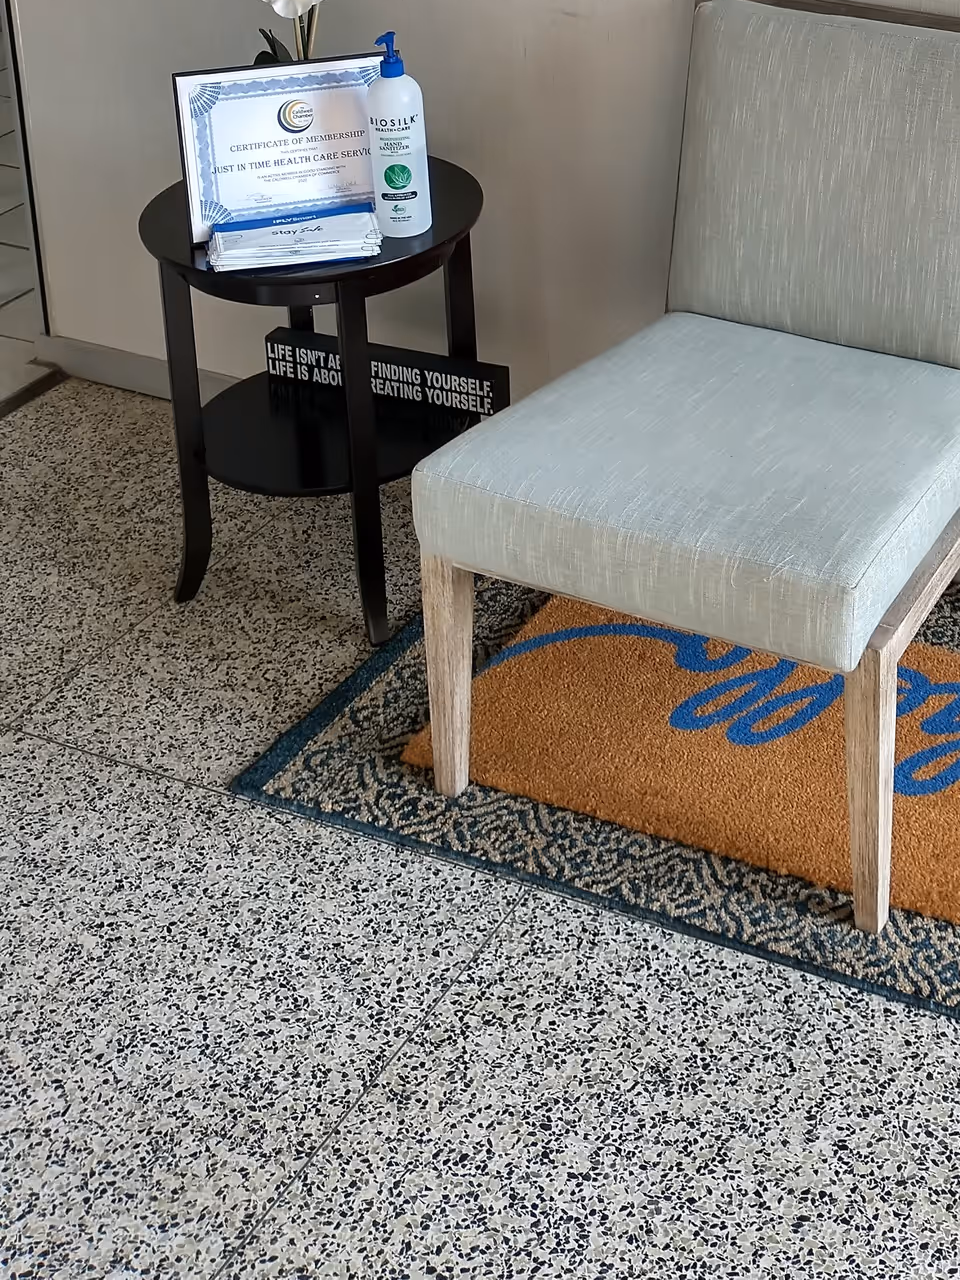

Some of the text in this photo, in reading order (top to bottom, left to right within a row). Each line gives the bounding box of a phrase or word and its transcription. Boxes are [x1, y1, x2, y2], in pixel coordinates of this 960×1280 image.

[370, 114, 416, 127] BIOSILK
[230, 130, 366, 152] CERTIFICATE OF MEMBERSHIP
[212, 164, 234, 174] JUST
[237, 163, 246, 171] IN
[248, 160, 271, 170] TIME
[274, 156, 310, 167] HEALTH
[314, 151, 338, 162] CARE
[341, 146, 371, 160] SERVIC
[267, 342, 293, 362] LIFE
[296, 347, 326, 368] ISN'T
[370, 360, 421, 384] FINDING
[424, 370, 493, 398] YOURSELF.
[268, 358, 494, 415] LIFE IS ABO REATING YOURSELF.
